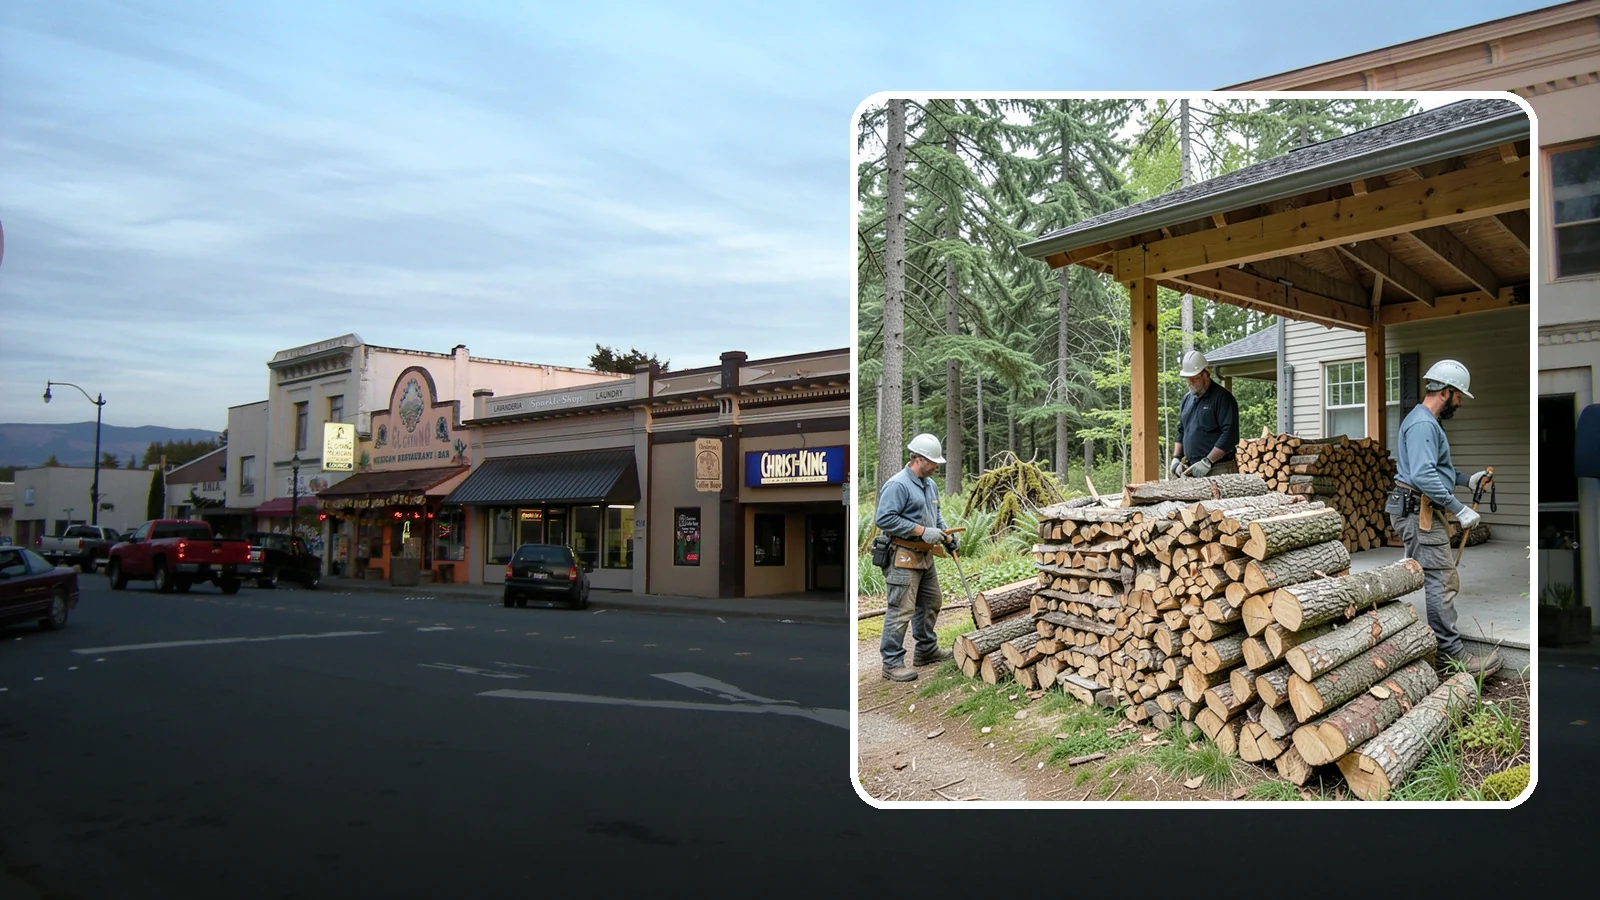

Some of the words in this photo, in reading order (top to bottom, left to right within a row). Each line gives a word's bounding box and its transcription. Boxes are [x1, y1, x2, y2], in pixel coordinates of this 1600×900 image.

[530, 397, 560, 408] Sparkle
[562, 394, 582, 405] Shop
[596, 389, 623, 400] LAUNDRY
[494, 402, 522, 412] LAVANDERIA
[374, 455, 396, 464] MEXICAN
[398, 451, 433, 462] RESTAURANT
[438, 450, 450, 459] BAR
[761, 452, 796, 478] CHRIST
[799, 450, 827, 476] KING
